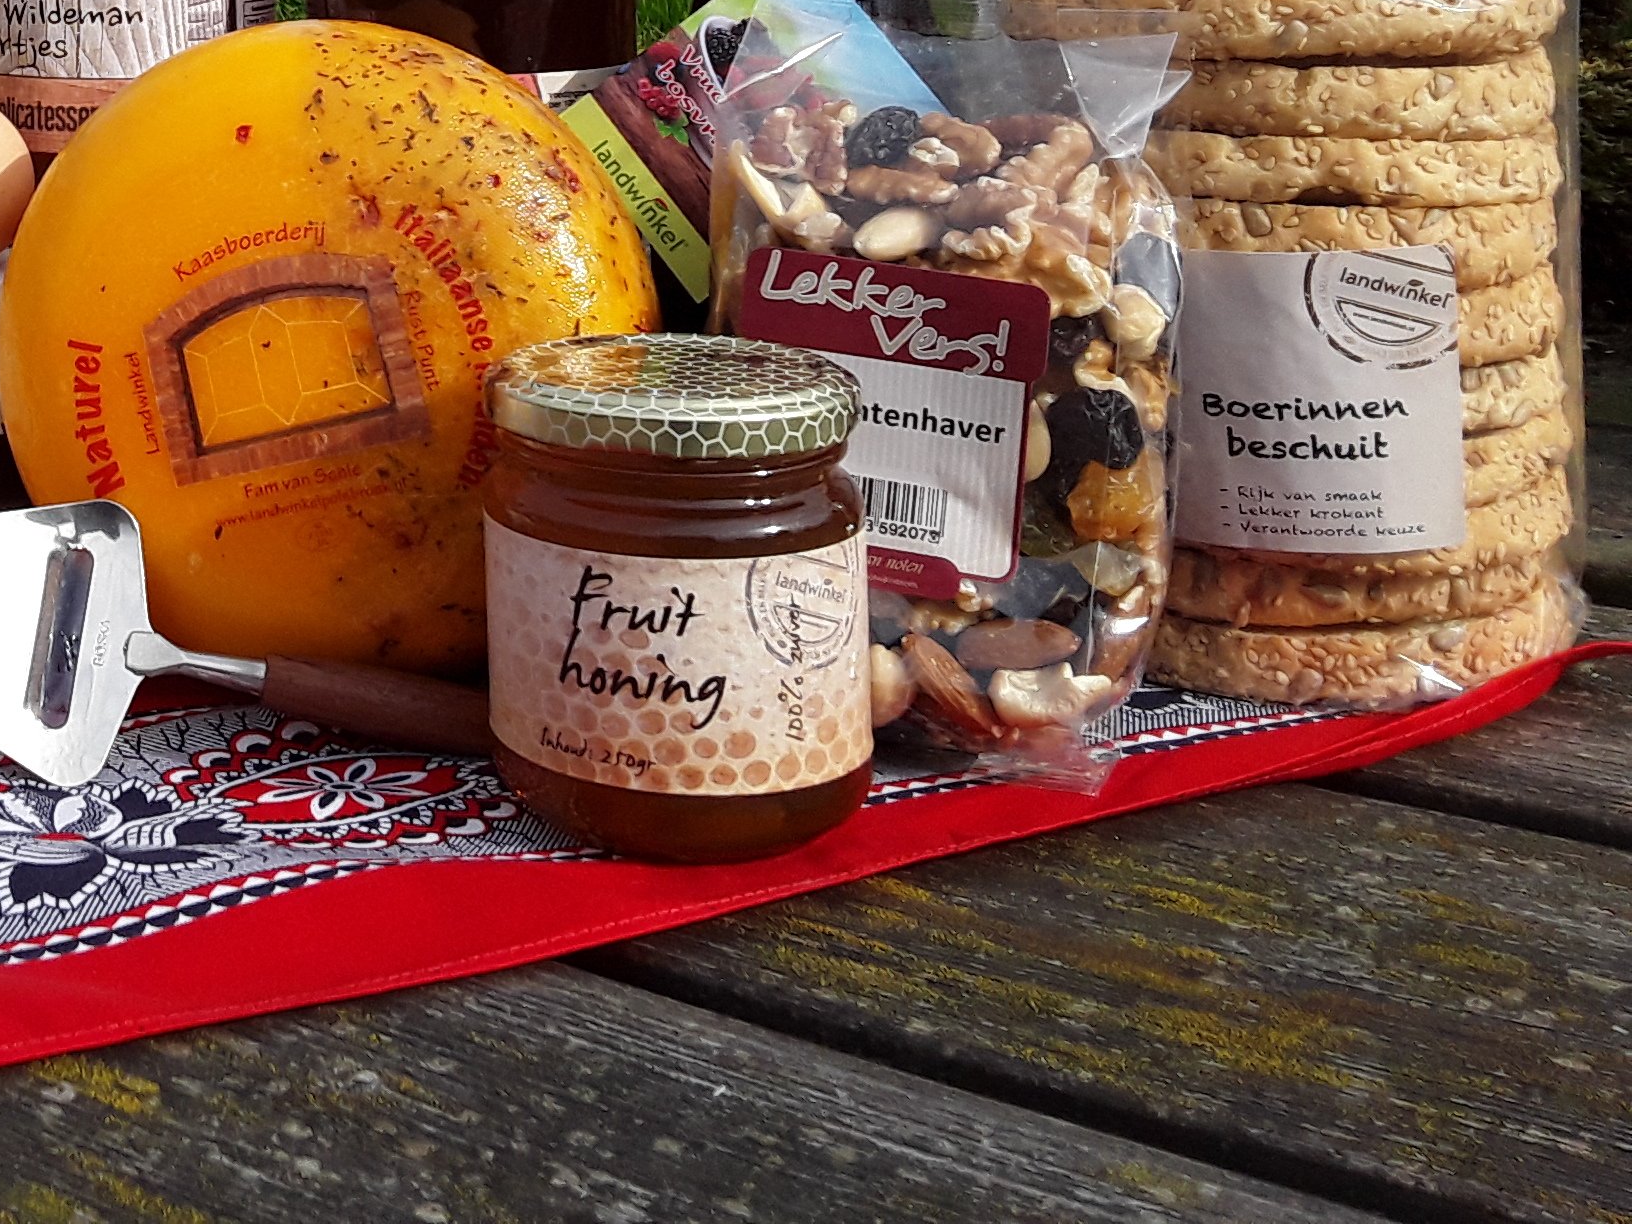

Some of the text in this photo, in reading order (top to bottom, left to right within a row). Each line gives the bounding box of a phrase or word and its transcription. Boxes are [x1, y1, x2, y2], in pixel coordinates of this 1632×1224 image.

[656, 58, 716, 145] bosvr
[591, 140, 685, 253] landwinkel
[172, 220, 326, 282] Kaasboerderij
[393, 204, 494, 353] Italiaanse
[759, 249, 946, 318] Lekker
[1339, 266, 1453, 309] landwinkel
[406, 291, 440, 391] Rust Punt
[870, 314, 1011, 376] Vers!
[67, 339, 126, 499] Naturel
[124, 352, 160, 455] Landwinkel
[1202, 393, 1409, 421] Boerinnen
[1226, 426, 1389, 460] beschuit
[244, 482, 279, 499] Fam
[282, 475, 311, 491] van
[1237, 485, 1383, 505] Rijk van smaak
[1238, 503, 1385, 519] Lekker krokant
[1240, 521, 1426, 537] Verantwoorde keuze
[774, 571, 848, 603] landwinkel
[887, 556, 924, 574] noten
[569, 565, 706, 637] Fruit
[559, 627, 727, 730] honing
[777, 676, 805, 742] 100%
[539, 726, 657, 777] Inhoud: 250gr
